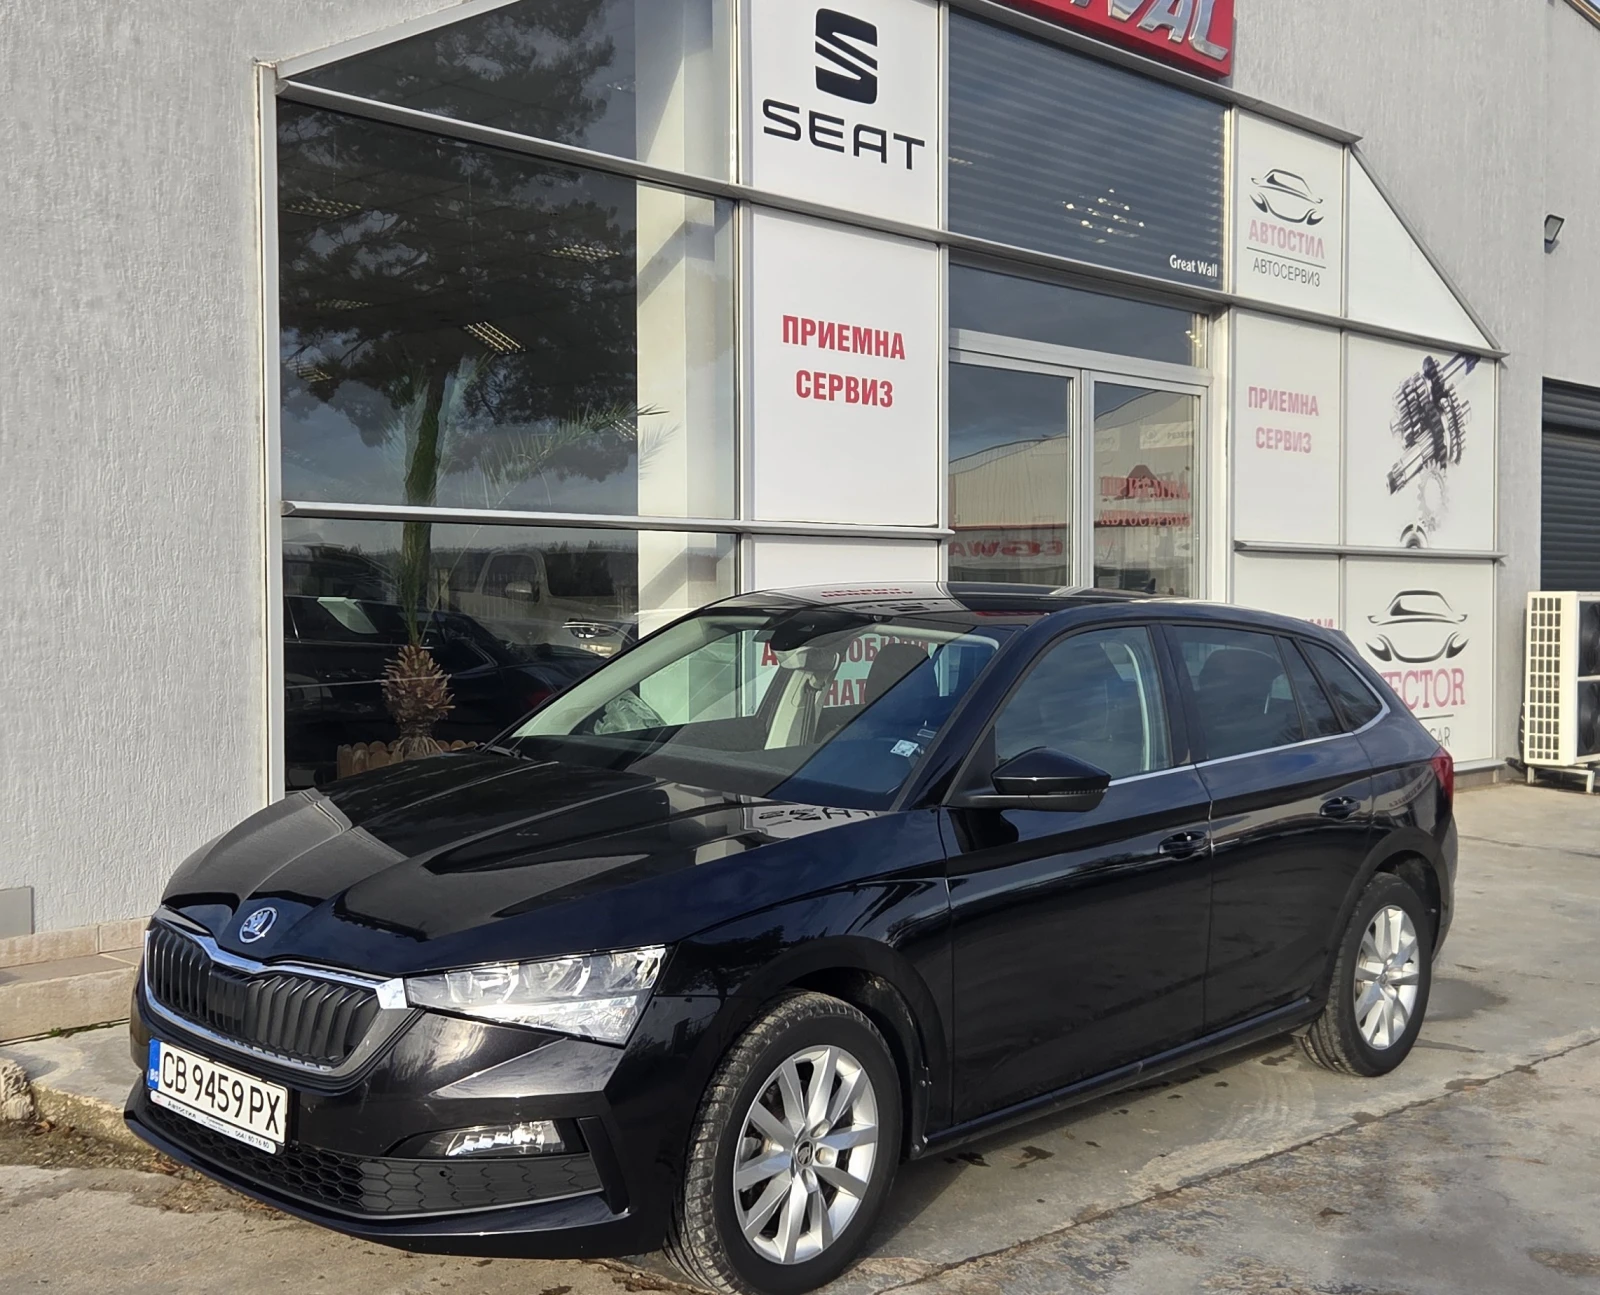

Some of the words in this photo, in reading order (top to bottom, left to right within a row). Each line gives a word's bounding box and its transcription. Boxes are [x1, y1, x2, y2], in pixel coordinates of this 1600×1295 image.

[762, 99, 925, 170] SEAT
[1248, 219, 1325, 260] АВТОСТИЛ
[1169, 254, 1196, 274] Great
[1197, 257, 1218, 278] Wall
[1252, 257, 1321, 288] АВТОСЕРВИЗ
[782, 315, 905, 361] ПРИЕМНА
[795, 369, 893, 408] СЕРВИЗ
[1248, 386, 1319, 417] ПРИЕМНА
[1255, 426, 1312, 454] СЕРВИЗ
[1381, 667, 1466, 711] ECTOR
[163, 1051, 187, 1095] CB
[193, 1064, 244, 1118] 9459
[249, 1085, 281, 1135] PX
